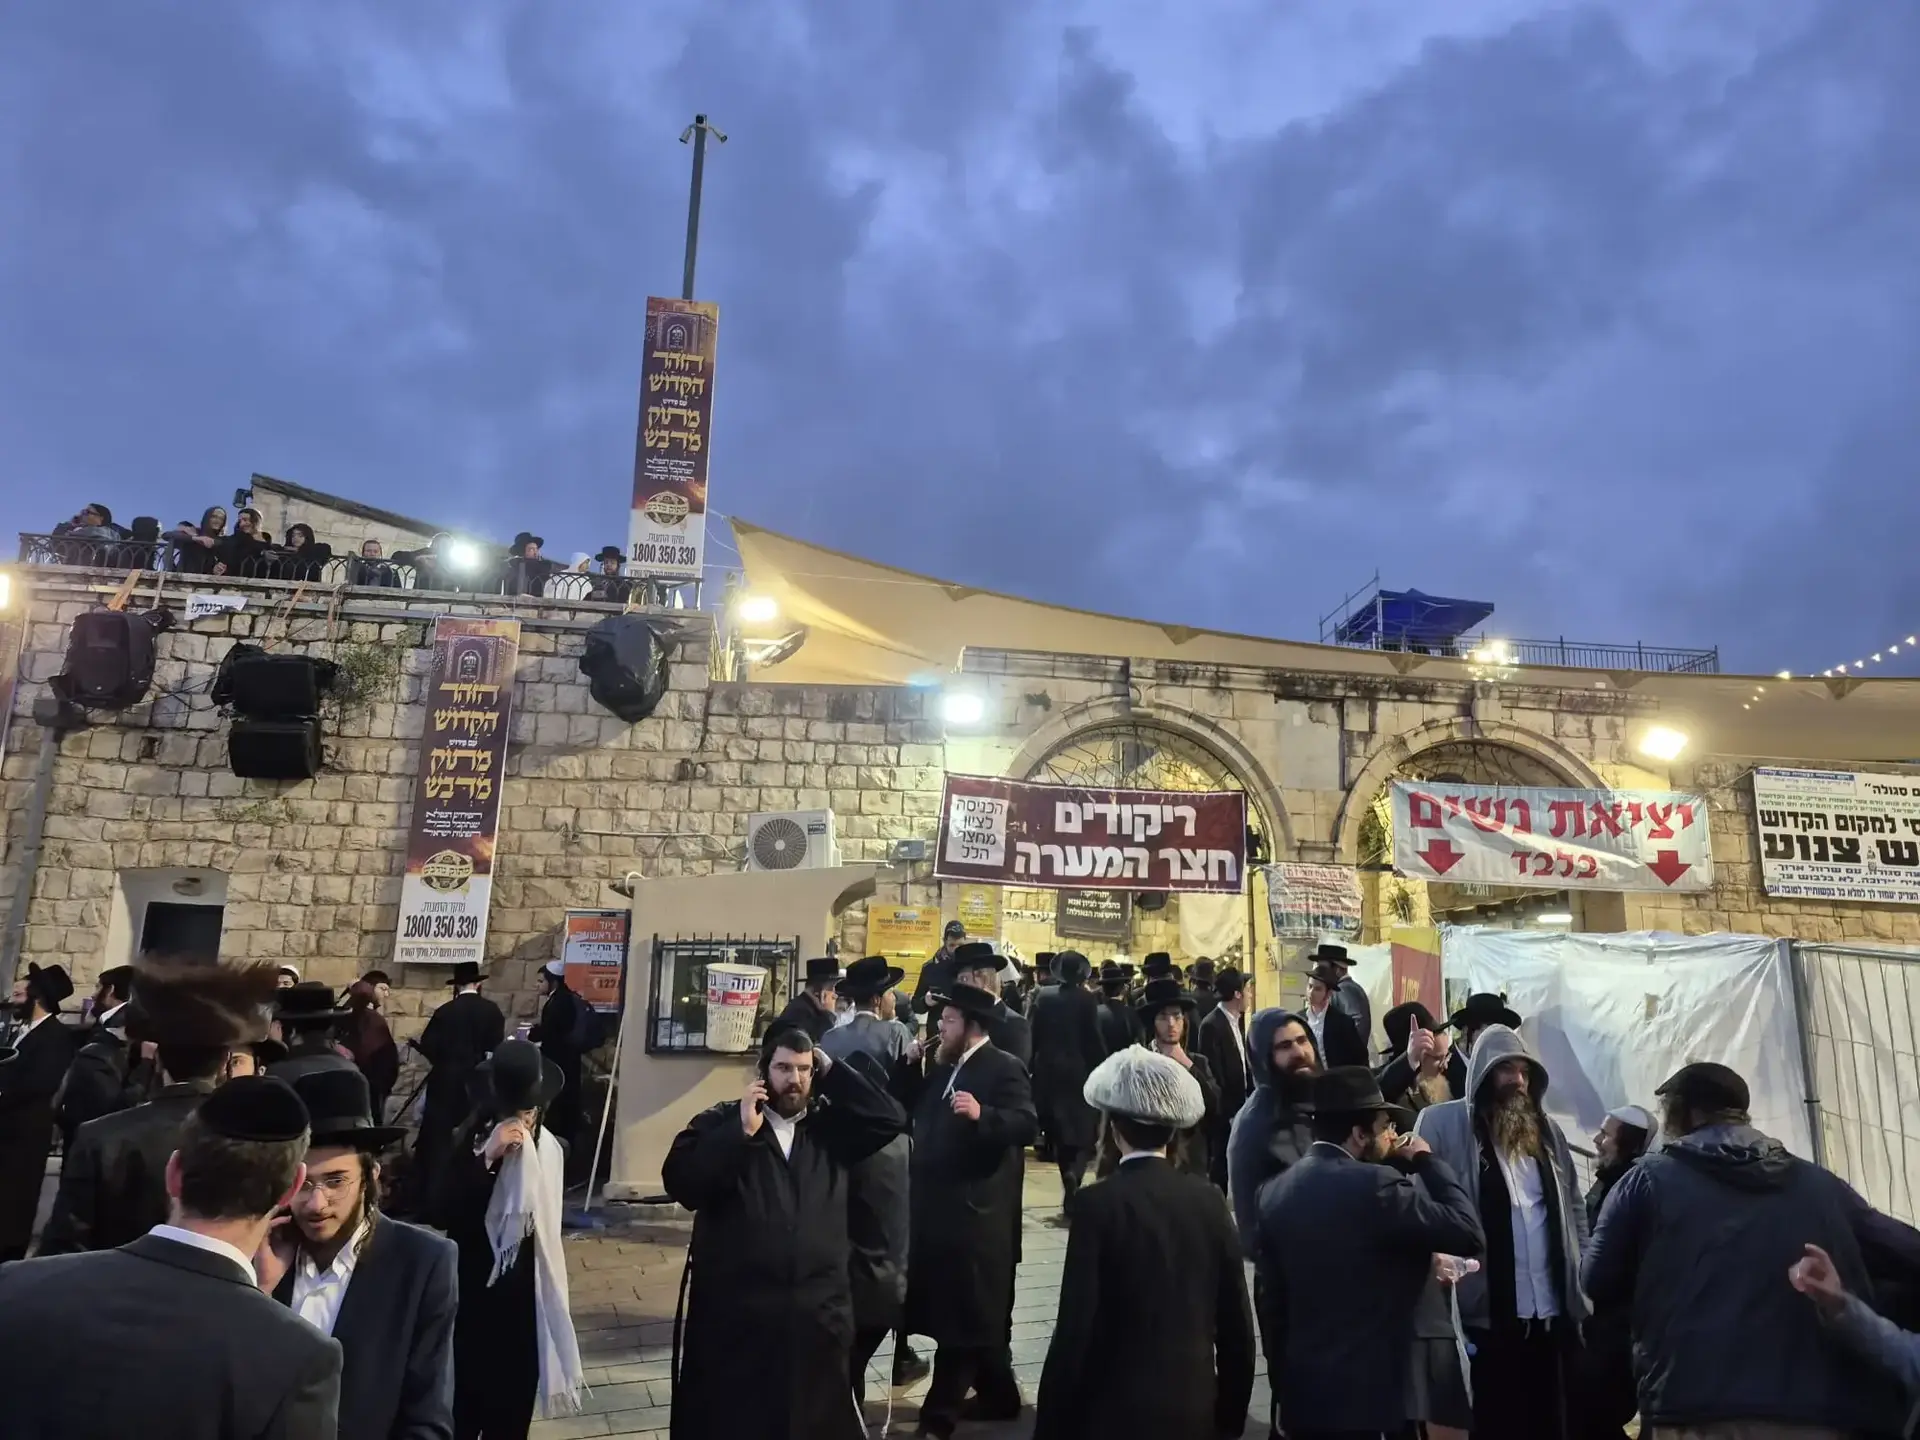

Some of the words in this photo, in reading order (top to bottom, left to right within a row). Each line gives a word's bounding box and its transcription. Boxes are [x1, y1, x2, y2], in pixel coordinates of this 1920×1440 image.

[632, 543, 656, 563] 1800
[658, 545, 676, 565] 350
[678, 546, 696, 566] 330
[955, 798, 1004, 815] הכניסה
[1407, 791, 1533, 836] נשים
[963, 815, 994, 830] לציון
[1055, 800, 1197, 843] ריקודים
[1547, 799, 1696, 841] יציאת
[1759, 809, 1829, 833] הקדוש
[1835, 813, 1897, 836] למקום
[957, 829, 997, 846] מחצר
[1762, 832, 1862, 864] צנוע
[961, 844, 990, 860] הלל
[1014, 841, 1150, 879] המערה
[1509, 847, 1599, 879] בלבד
[1157, 847, 1237, 882] חצר
[1808, 865, 1842, 873] שרוול
[1846, 867, 1861, 875] עם
[1797, 874, 1835, 882] בלבוש
[1838, 875, 1854, 883] לא
[1836, 887, 1846, 897] כל
[1867, 888, 1876, 900] לך
[404, 915, 432, 938] 1800
[434, 915, 455, 938] 350
[457, 915, 478, 938] 330
